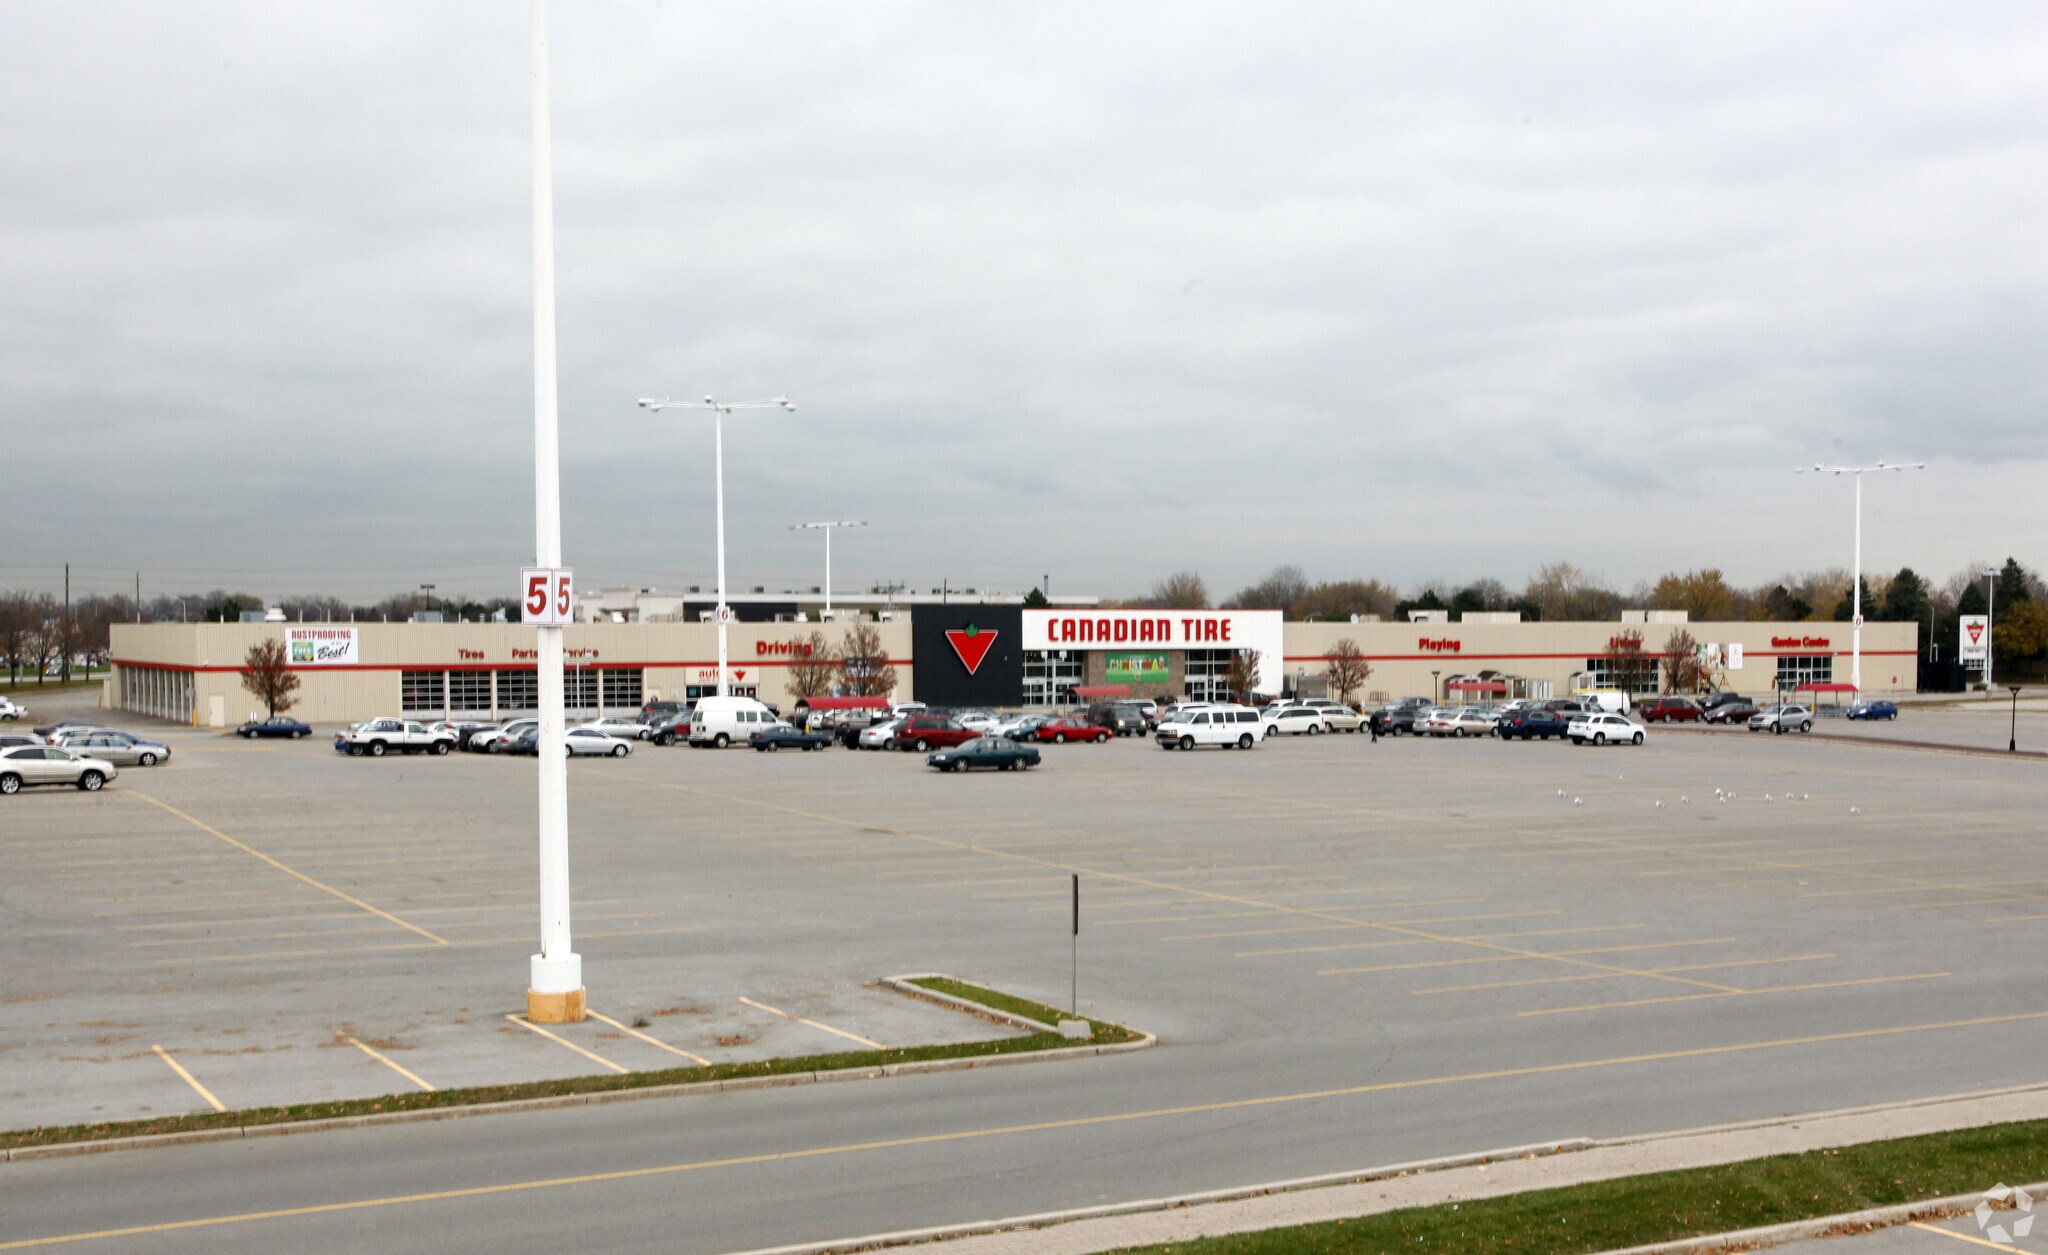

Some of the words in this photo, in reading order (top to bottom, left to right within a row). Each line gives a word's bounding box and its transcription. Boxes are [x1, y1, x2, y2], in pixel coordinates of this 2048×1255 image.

[526, 576, 548, 615] 5
[557, 577, 571, 615] 5
[721, 609, 728, 620] 6
[291, 630, 352, 640] RUSTPROOFING
[1048, 618, 1171, 642] CANADIAN
[1181, 618, 1231, 642] TIRE
[756, 639, 812, 657] Driving
[1419, 638, 1461, 653] Playing
[1772, 636, 1802, 648] Garden
[458, 649, 485, 659] Tires
[563, 647, 599, 659] ervie
